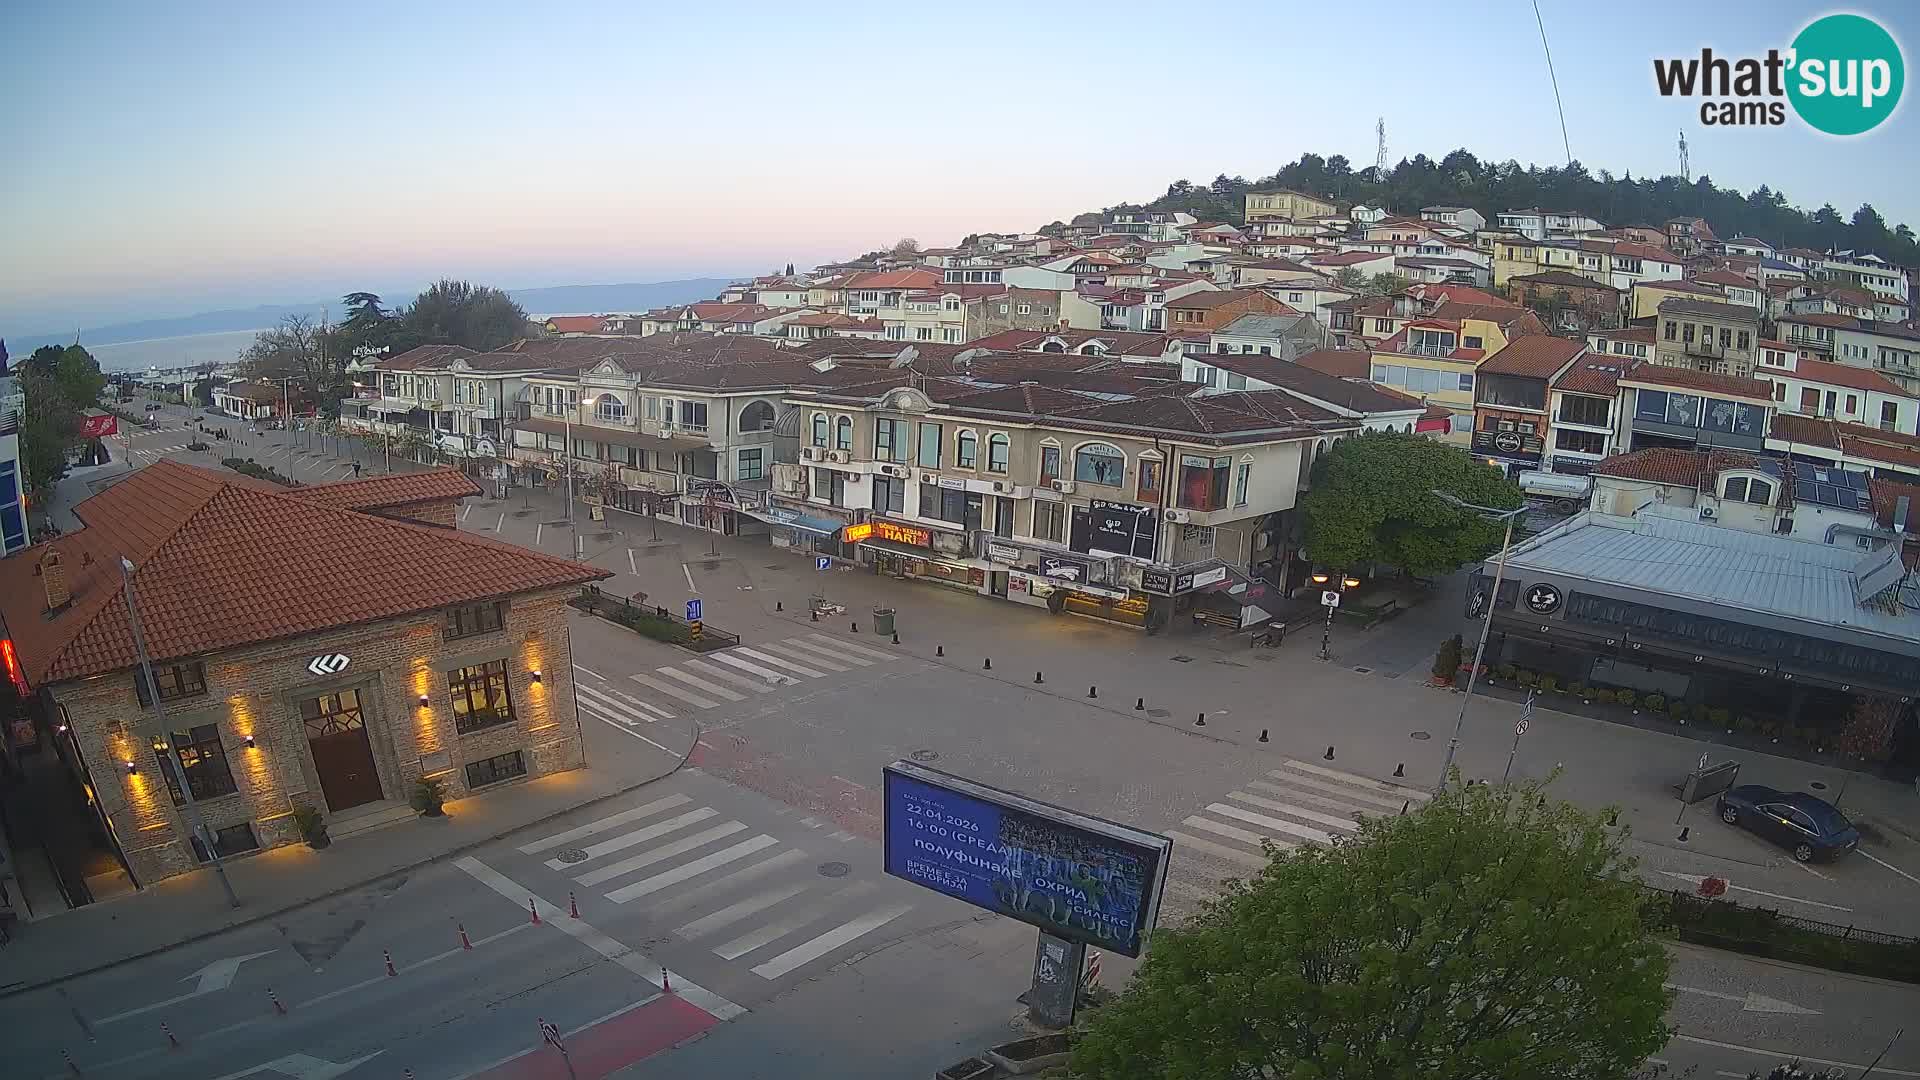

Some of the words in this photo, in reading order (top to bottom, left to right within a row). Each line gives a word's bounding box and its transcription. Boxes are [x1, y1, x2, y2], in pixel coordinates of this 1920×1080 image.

[819, 558, 828, 568] P
[906, 803, 979, 832] 22.04.2026
[907, 818, 948, 837] 16:00
[914, 838, 1023, 879] полуфинале
[1073, 905, 1129, 927] СИЛЕКС
